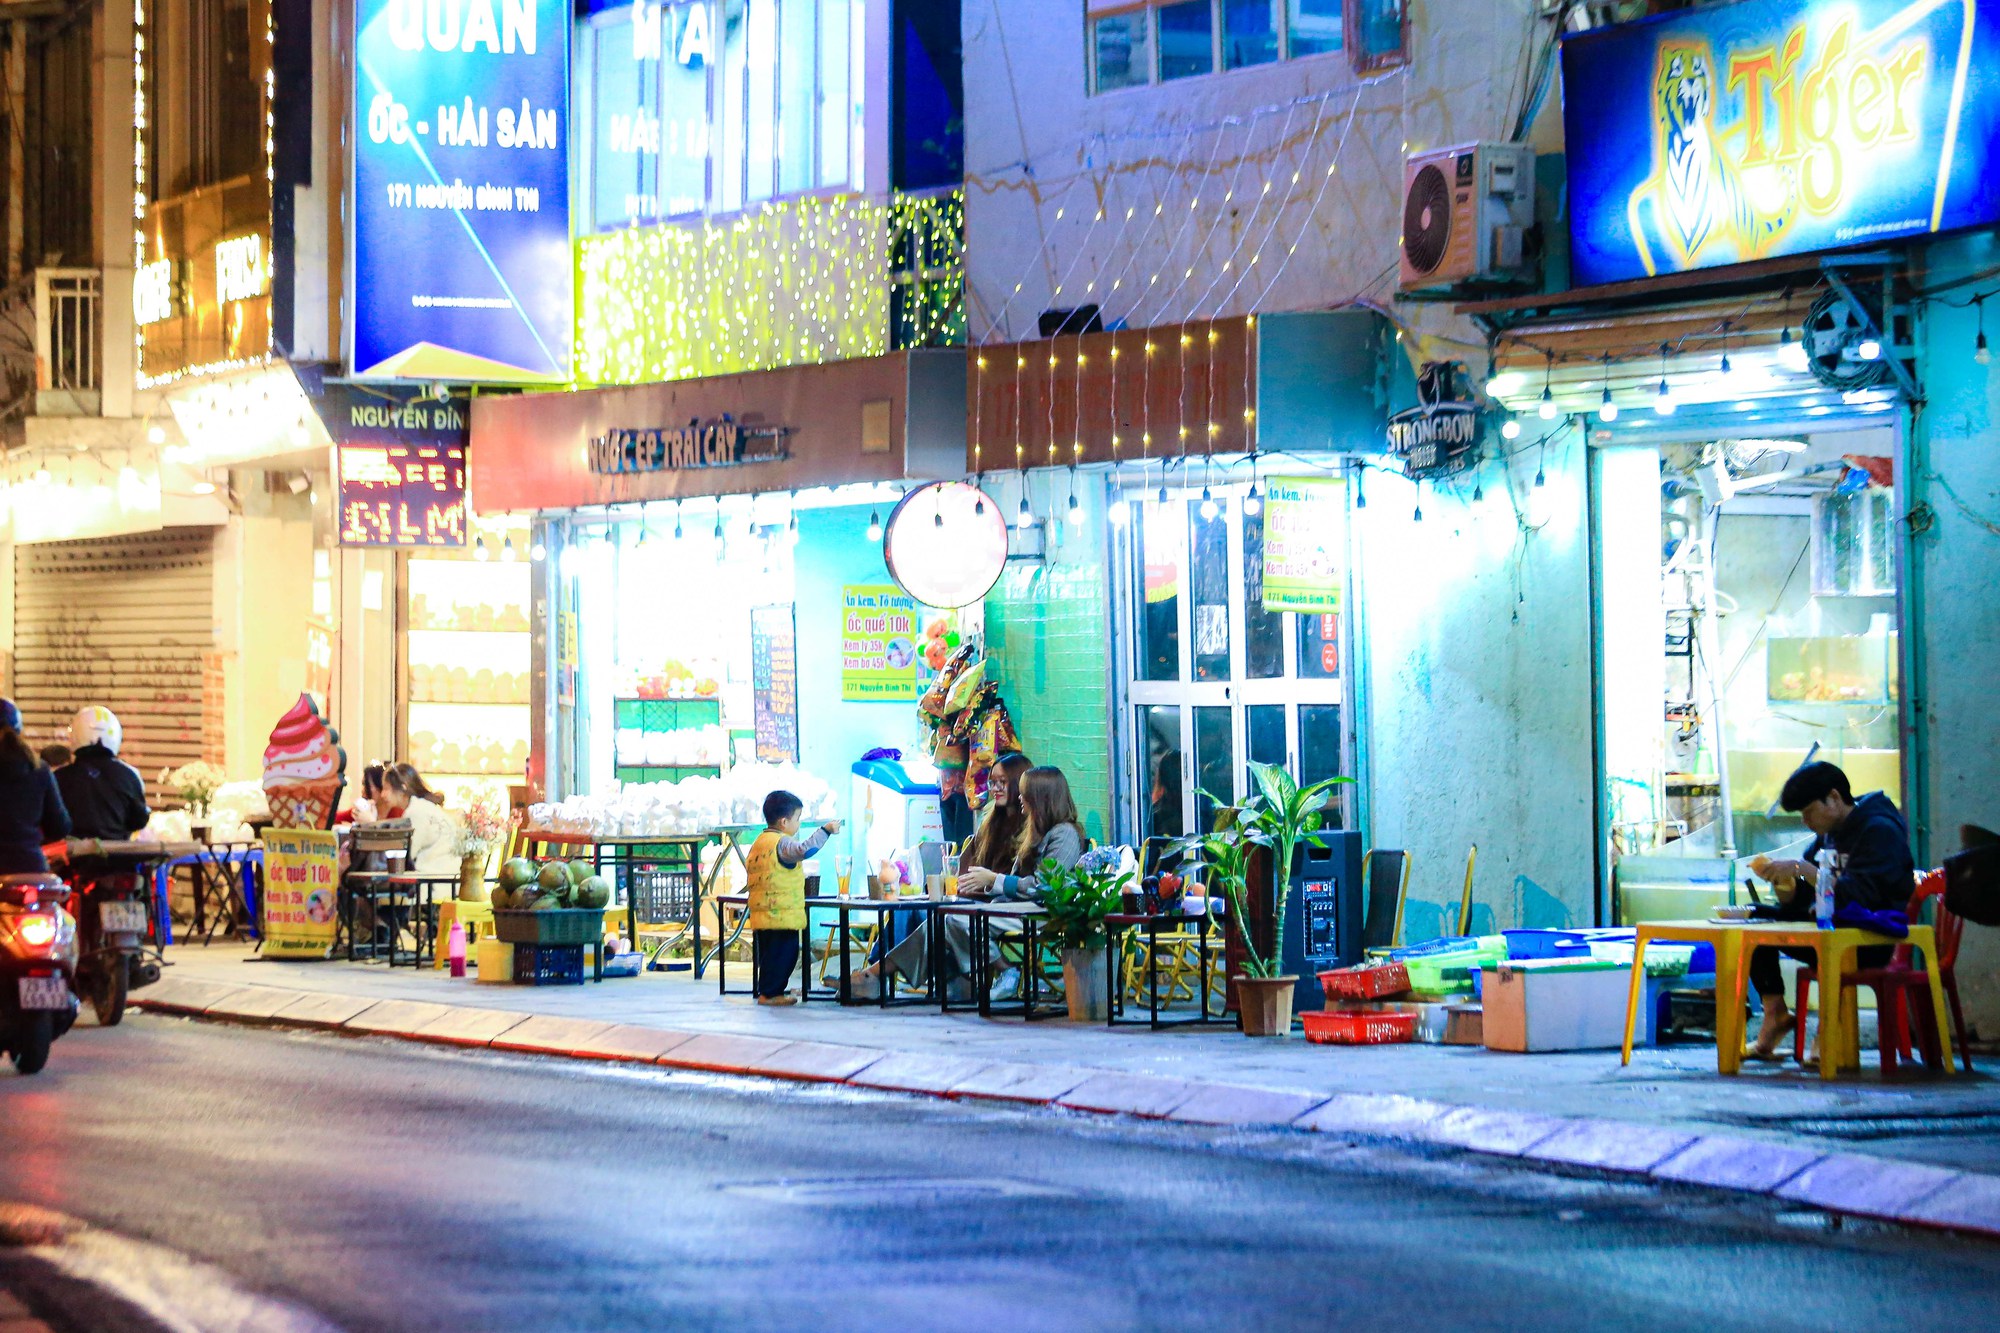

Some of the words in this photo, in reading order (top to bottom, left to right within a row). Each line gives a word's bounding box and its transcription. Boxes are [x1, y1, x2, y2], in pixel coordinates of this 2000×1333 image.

[1728, 14, 1926, 216] Tiger
[434, 405, 464, 431] ĐÌN
[1386, 413, 1476, 453] STRONGBOW
[889, 616, 909, 632] 10k
[844, 640, 860, 651] Kem
[844, 657, 859, 669] Kem
[312, 864, 331, 883] 10k
